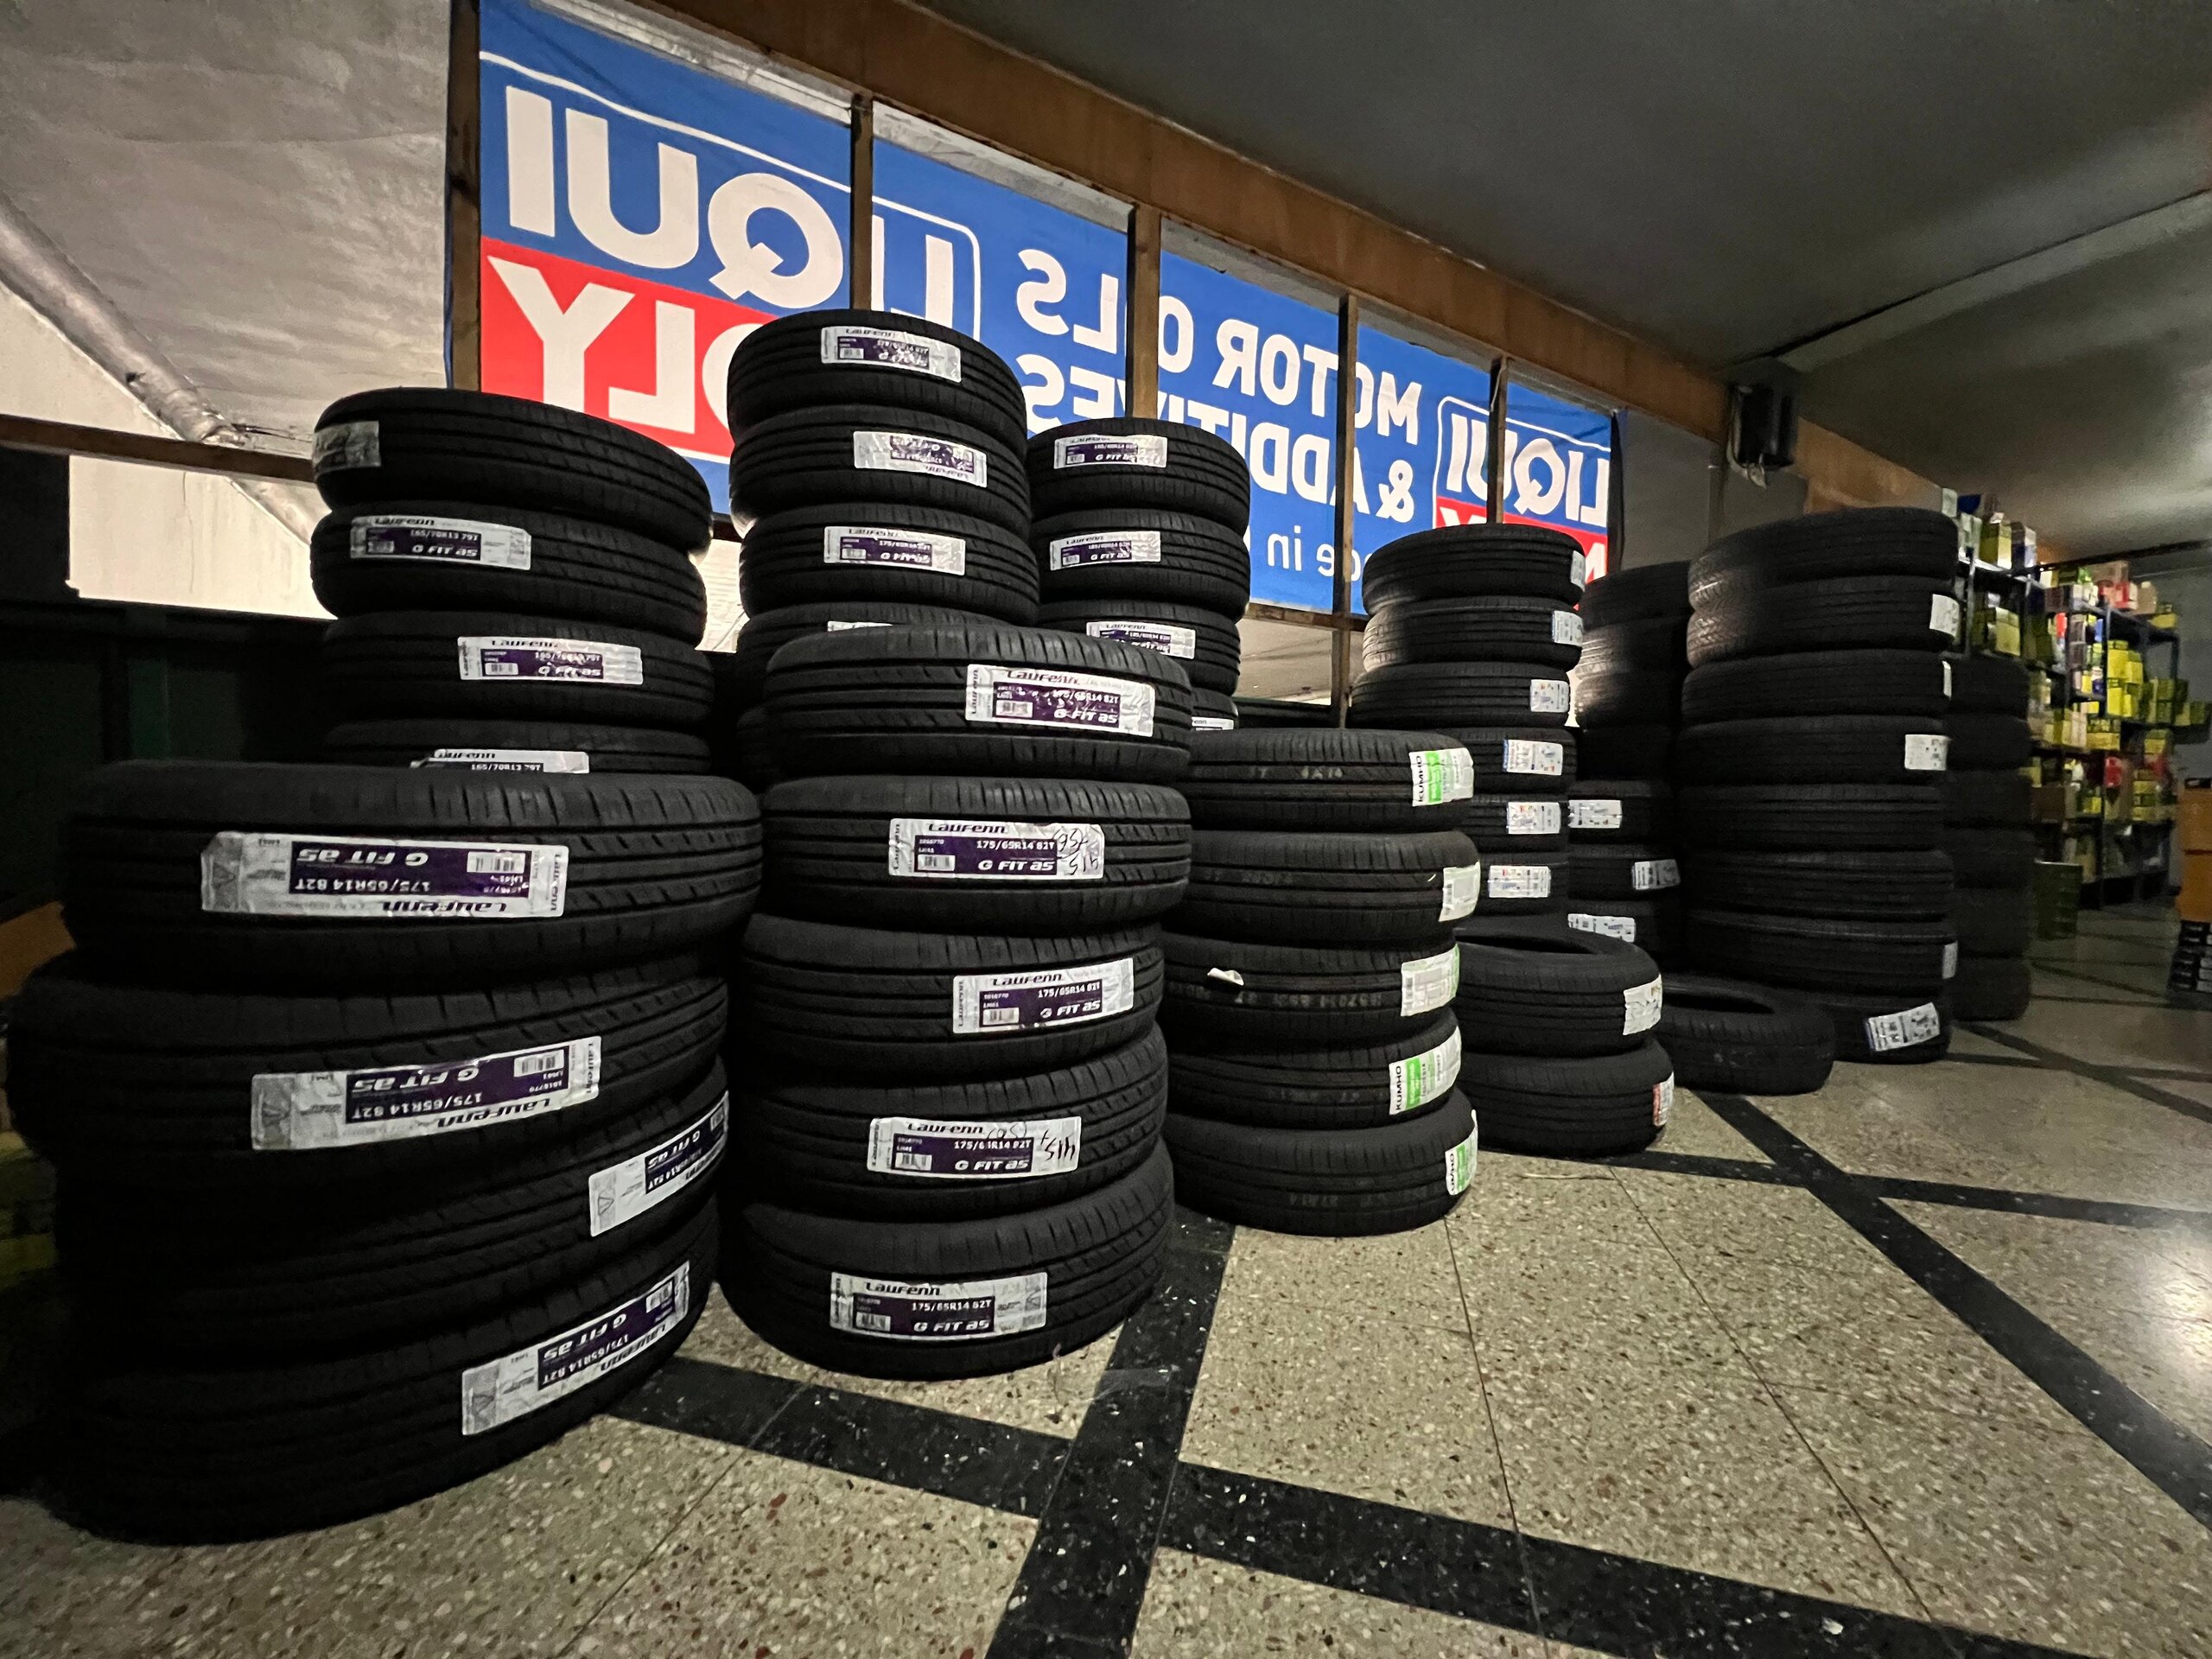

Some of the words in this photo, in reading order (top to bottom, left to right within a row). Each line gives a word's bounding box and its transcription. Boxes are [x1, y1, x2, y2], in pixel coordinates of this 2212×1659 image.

[411, 544, 424, 554] G
[427, 544, 453, 556] FIT
[1415, 755, 1424, 803] KUMHO
[976, 840, 1034, 851] 175/65R14
[348, 850, 397, 865] FIT
[404, 852, 430, 866] G
[977, 860, 993, 871] G
[997, 860, 1028, 871] FIT
[294, 878, 327, 891] 82T
[333, 879, 430, 893] 175/65R14
[1056, 1003, 1081, 1016] FIT
[401, 1069, 449, 1090] FIT
[457, 1066, 481, 1081] G
[389, 1091, 483, 1116] 175/65R14
[954, 1160, 969, 1171] G
[973, 1160, 1005, 1171] FIT
[613, 1313, 627, 1329] G
[913, 1321, 927, 1332] G
[933, 1320, 965, 1332] FIT
[579, 1322, 608, 1344] FIT
